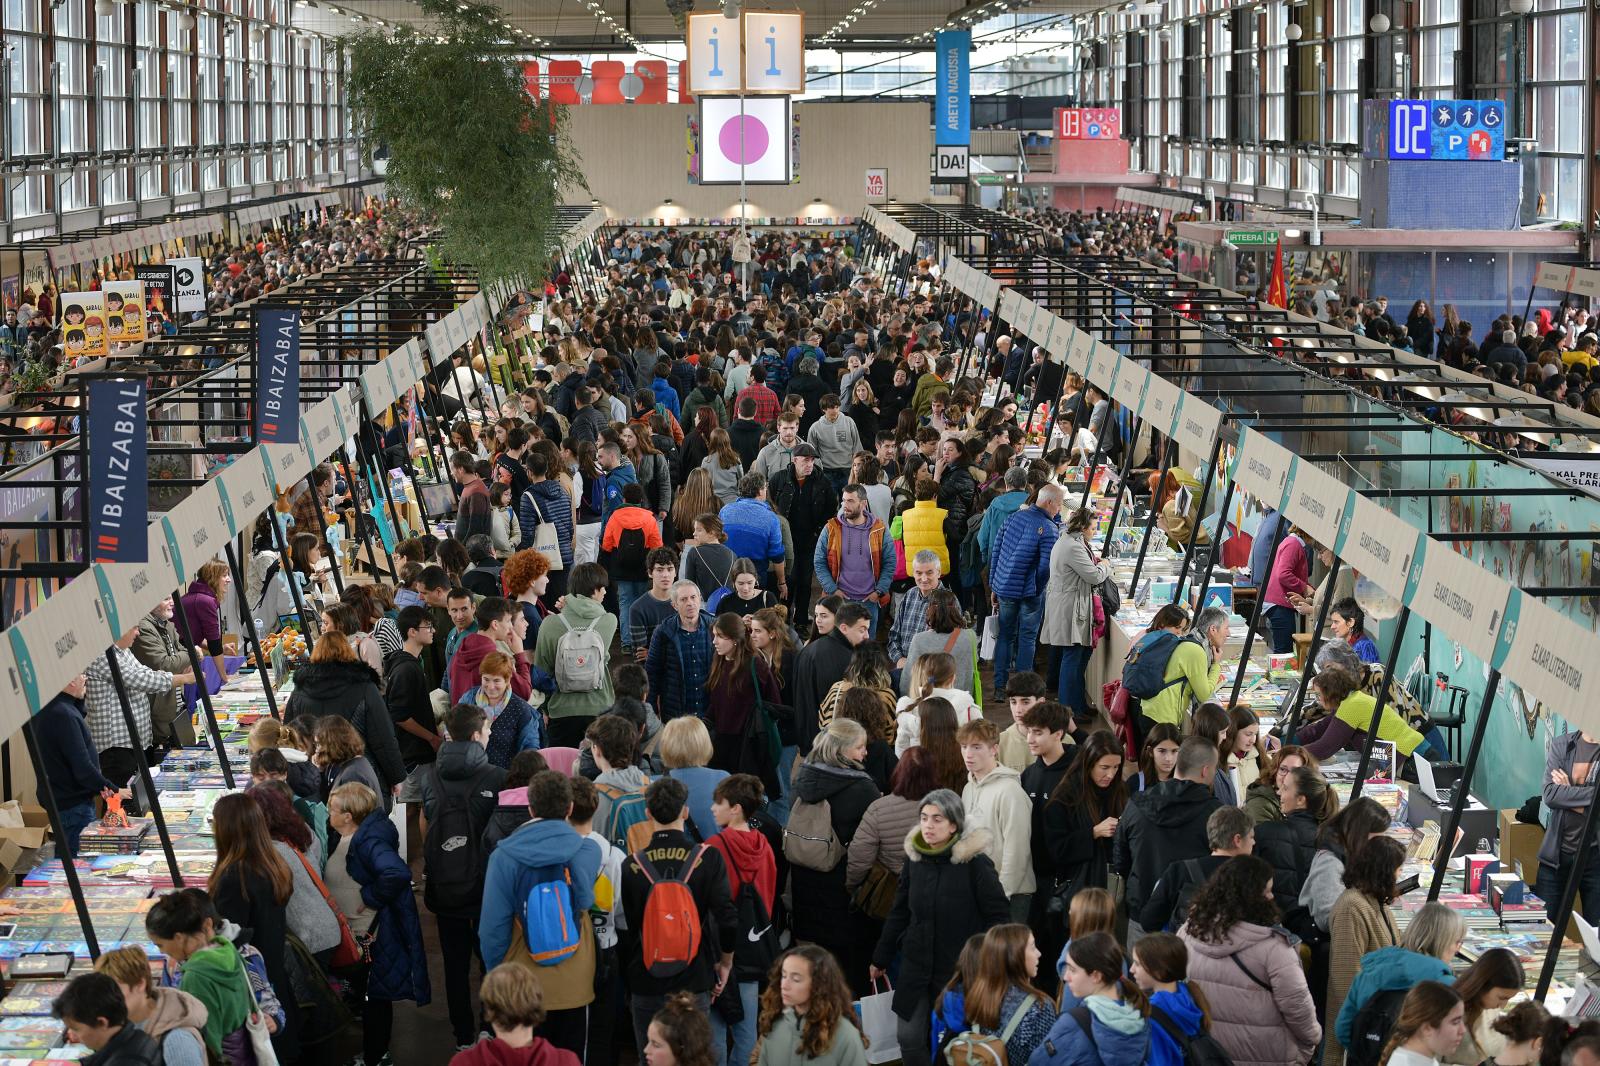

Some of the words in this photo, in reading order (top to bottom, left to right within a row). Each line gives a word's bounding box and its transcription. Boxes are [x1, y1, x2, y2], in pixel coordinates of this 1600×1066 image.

[947, 48, 959, 94] NAGUSIA
[947, 96, 959, 130] ARETO
[1062, 110, 1080, 137] 03
[1395, 104, 1427, 154] 02
[867, 175, 883, 185] YA
[940, 154, 965, 169] DA!
[867, 186, 884, 195] NIZ
[265, 313, 296, 418] IBAIZABAL
[100, 384, 140, 528] IBAIZABAL
[1434, 582, 1450, 606] ELKAR
[1447, 589, 1474, 622] LITERATURA
[1532, 643, 1551, 670] ELKAR
[1550, 654, 1582, 692] LITERATURA
[630, 847, 703, 874] ATIGUO
